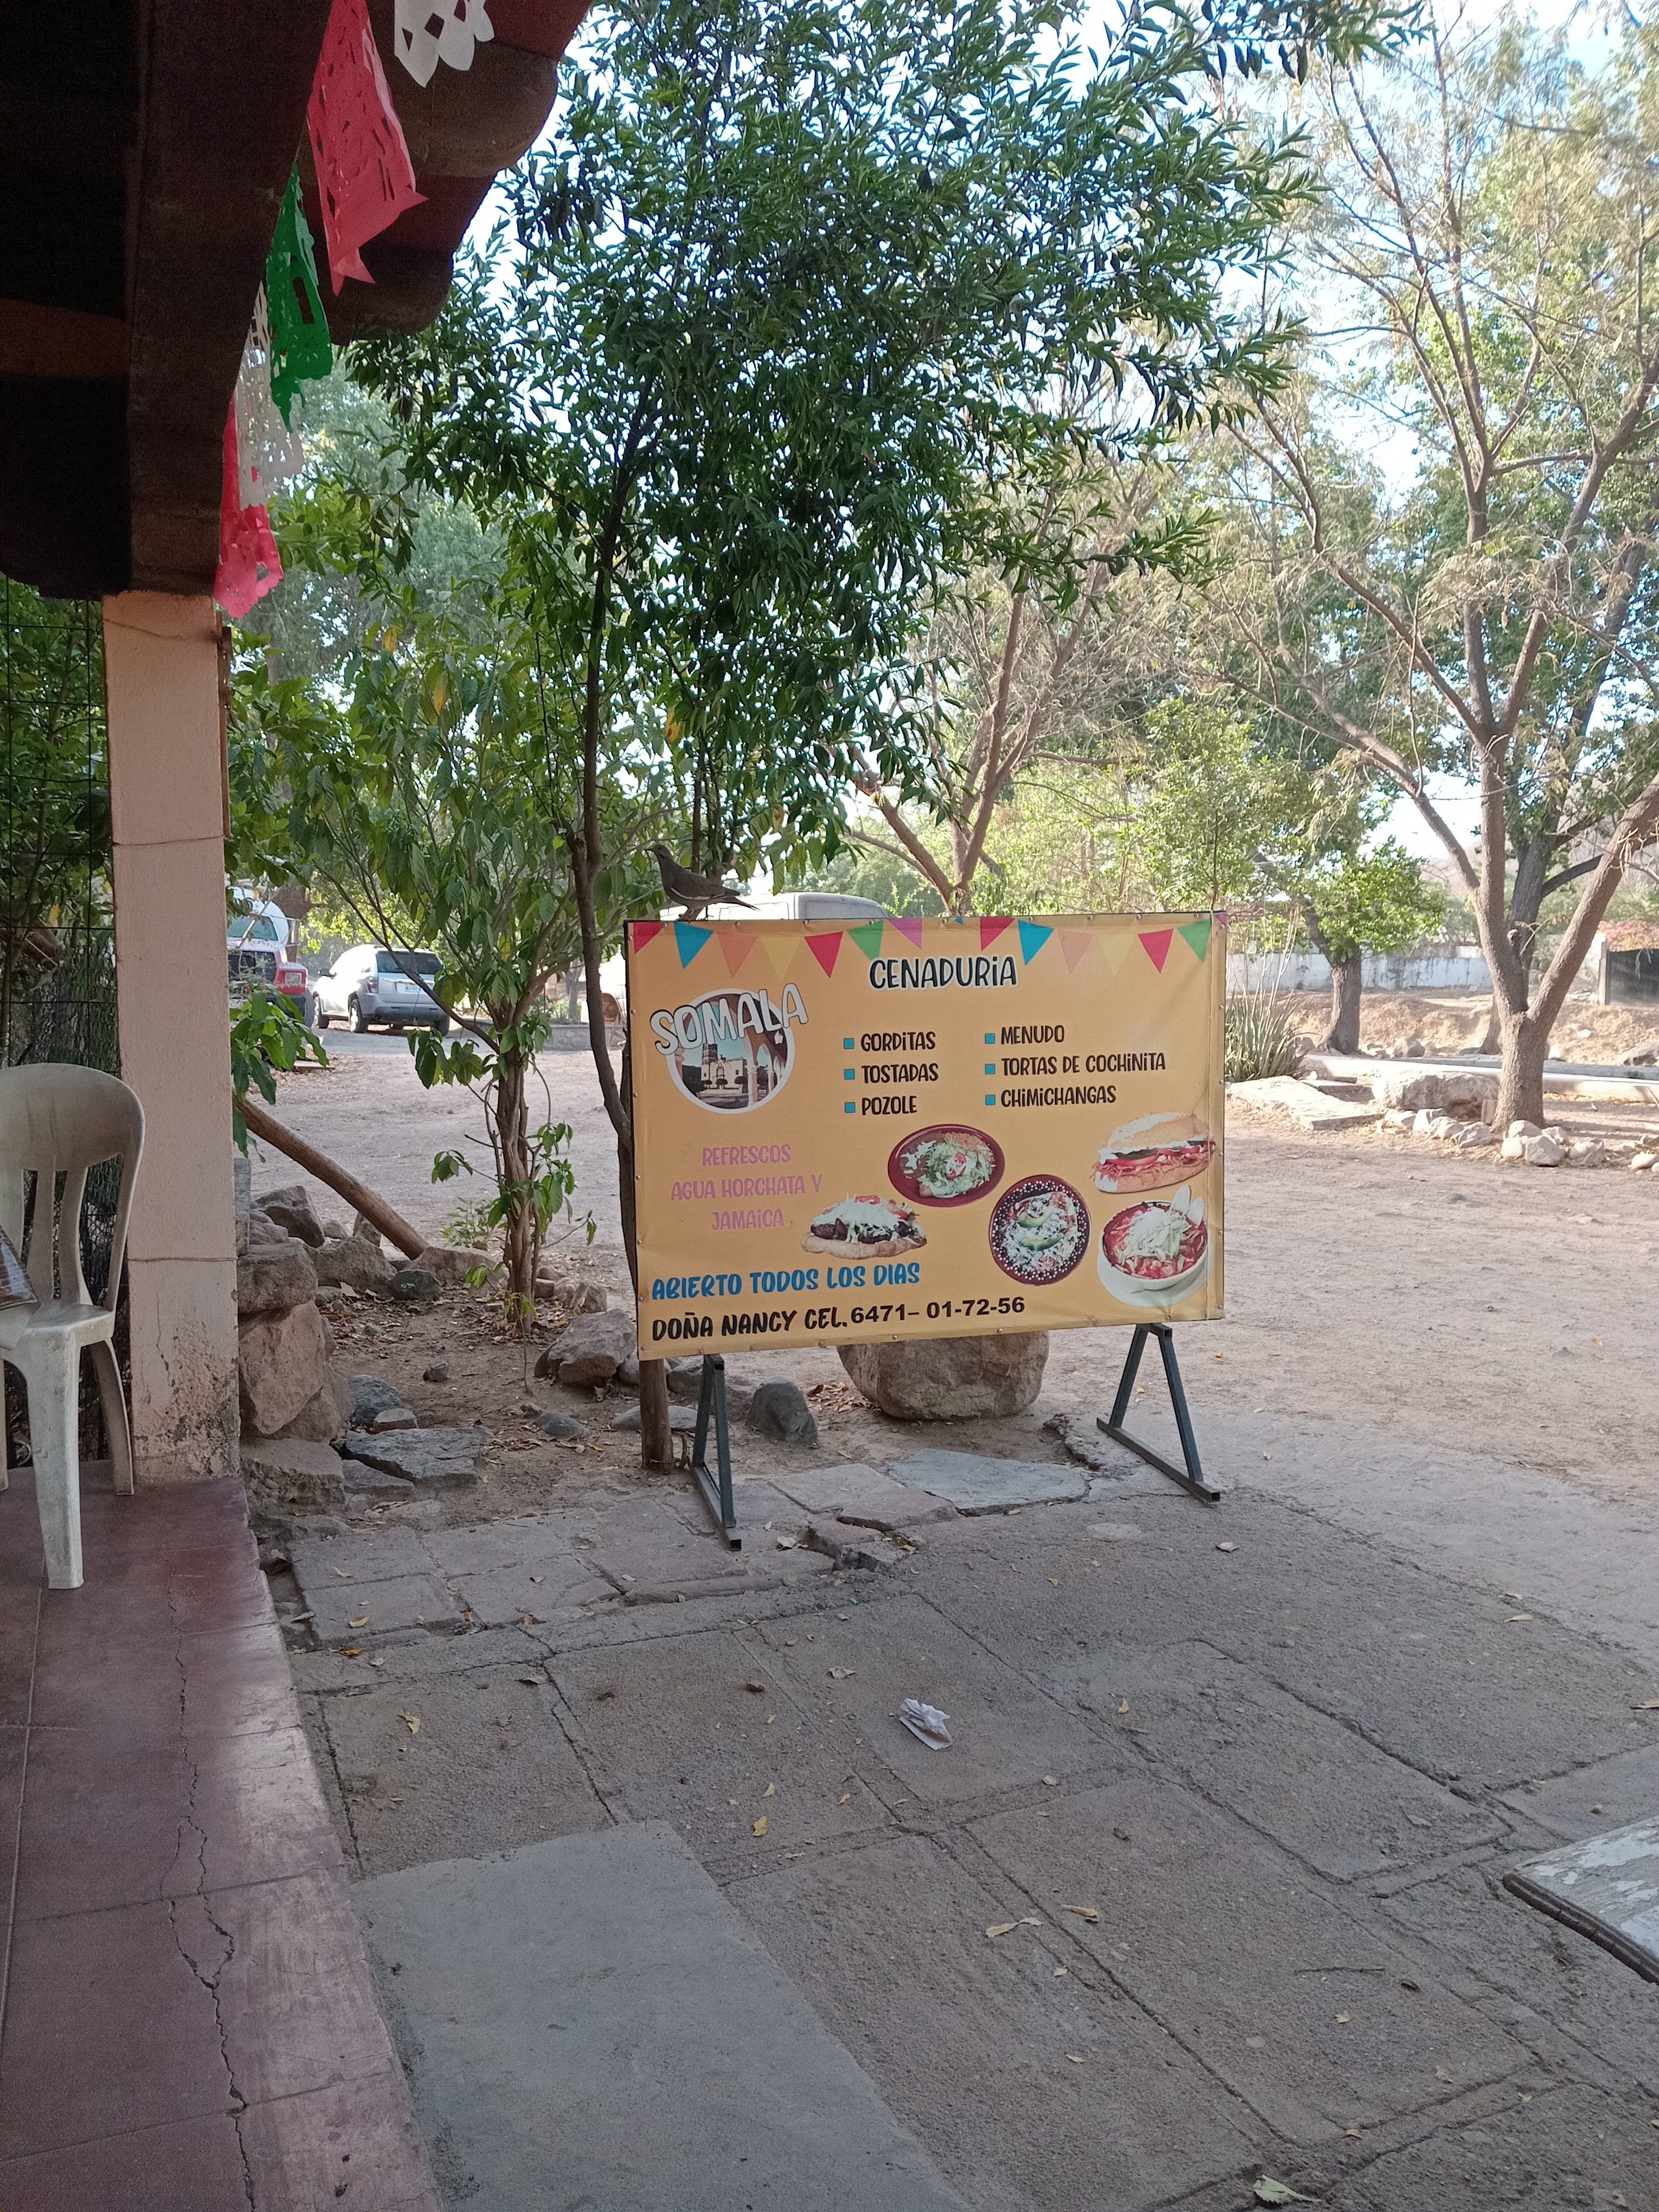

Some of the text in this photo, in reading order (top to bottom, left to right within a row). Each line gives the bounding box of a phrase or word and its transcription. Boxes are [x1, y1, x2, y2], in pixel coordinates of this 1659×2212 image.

[650, 983, 808, 1055] SOMALA
[1001, 1025, 1065, 1045] MENUDO
[861, 1063, 938, 1083] TOSTADAS
[1001, 1057, 1058, 1076] TORTAS
[1063, 1056, 1080, 1073] DE
[861, 1096, 917, 1116] POZOLE
[702, 1144, 792, 1167] REFRESCOS
[671, 1175, 822, 1201] AGUA HORCHATA Y
[652, 1263, 921, 1300] ABIERTO TODOS LOS DIAS
[652, 1313, 713, 1341] DOÑA
[721, 1310, 798, 1336] NANCY
[805, 1307, 847, 1329] CEL.
[927, 1296, 1025, 1319] 01-72-56
